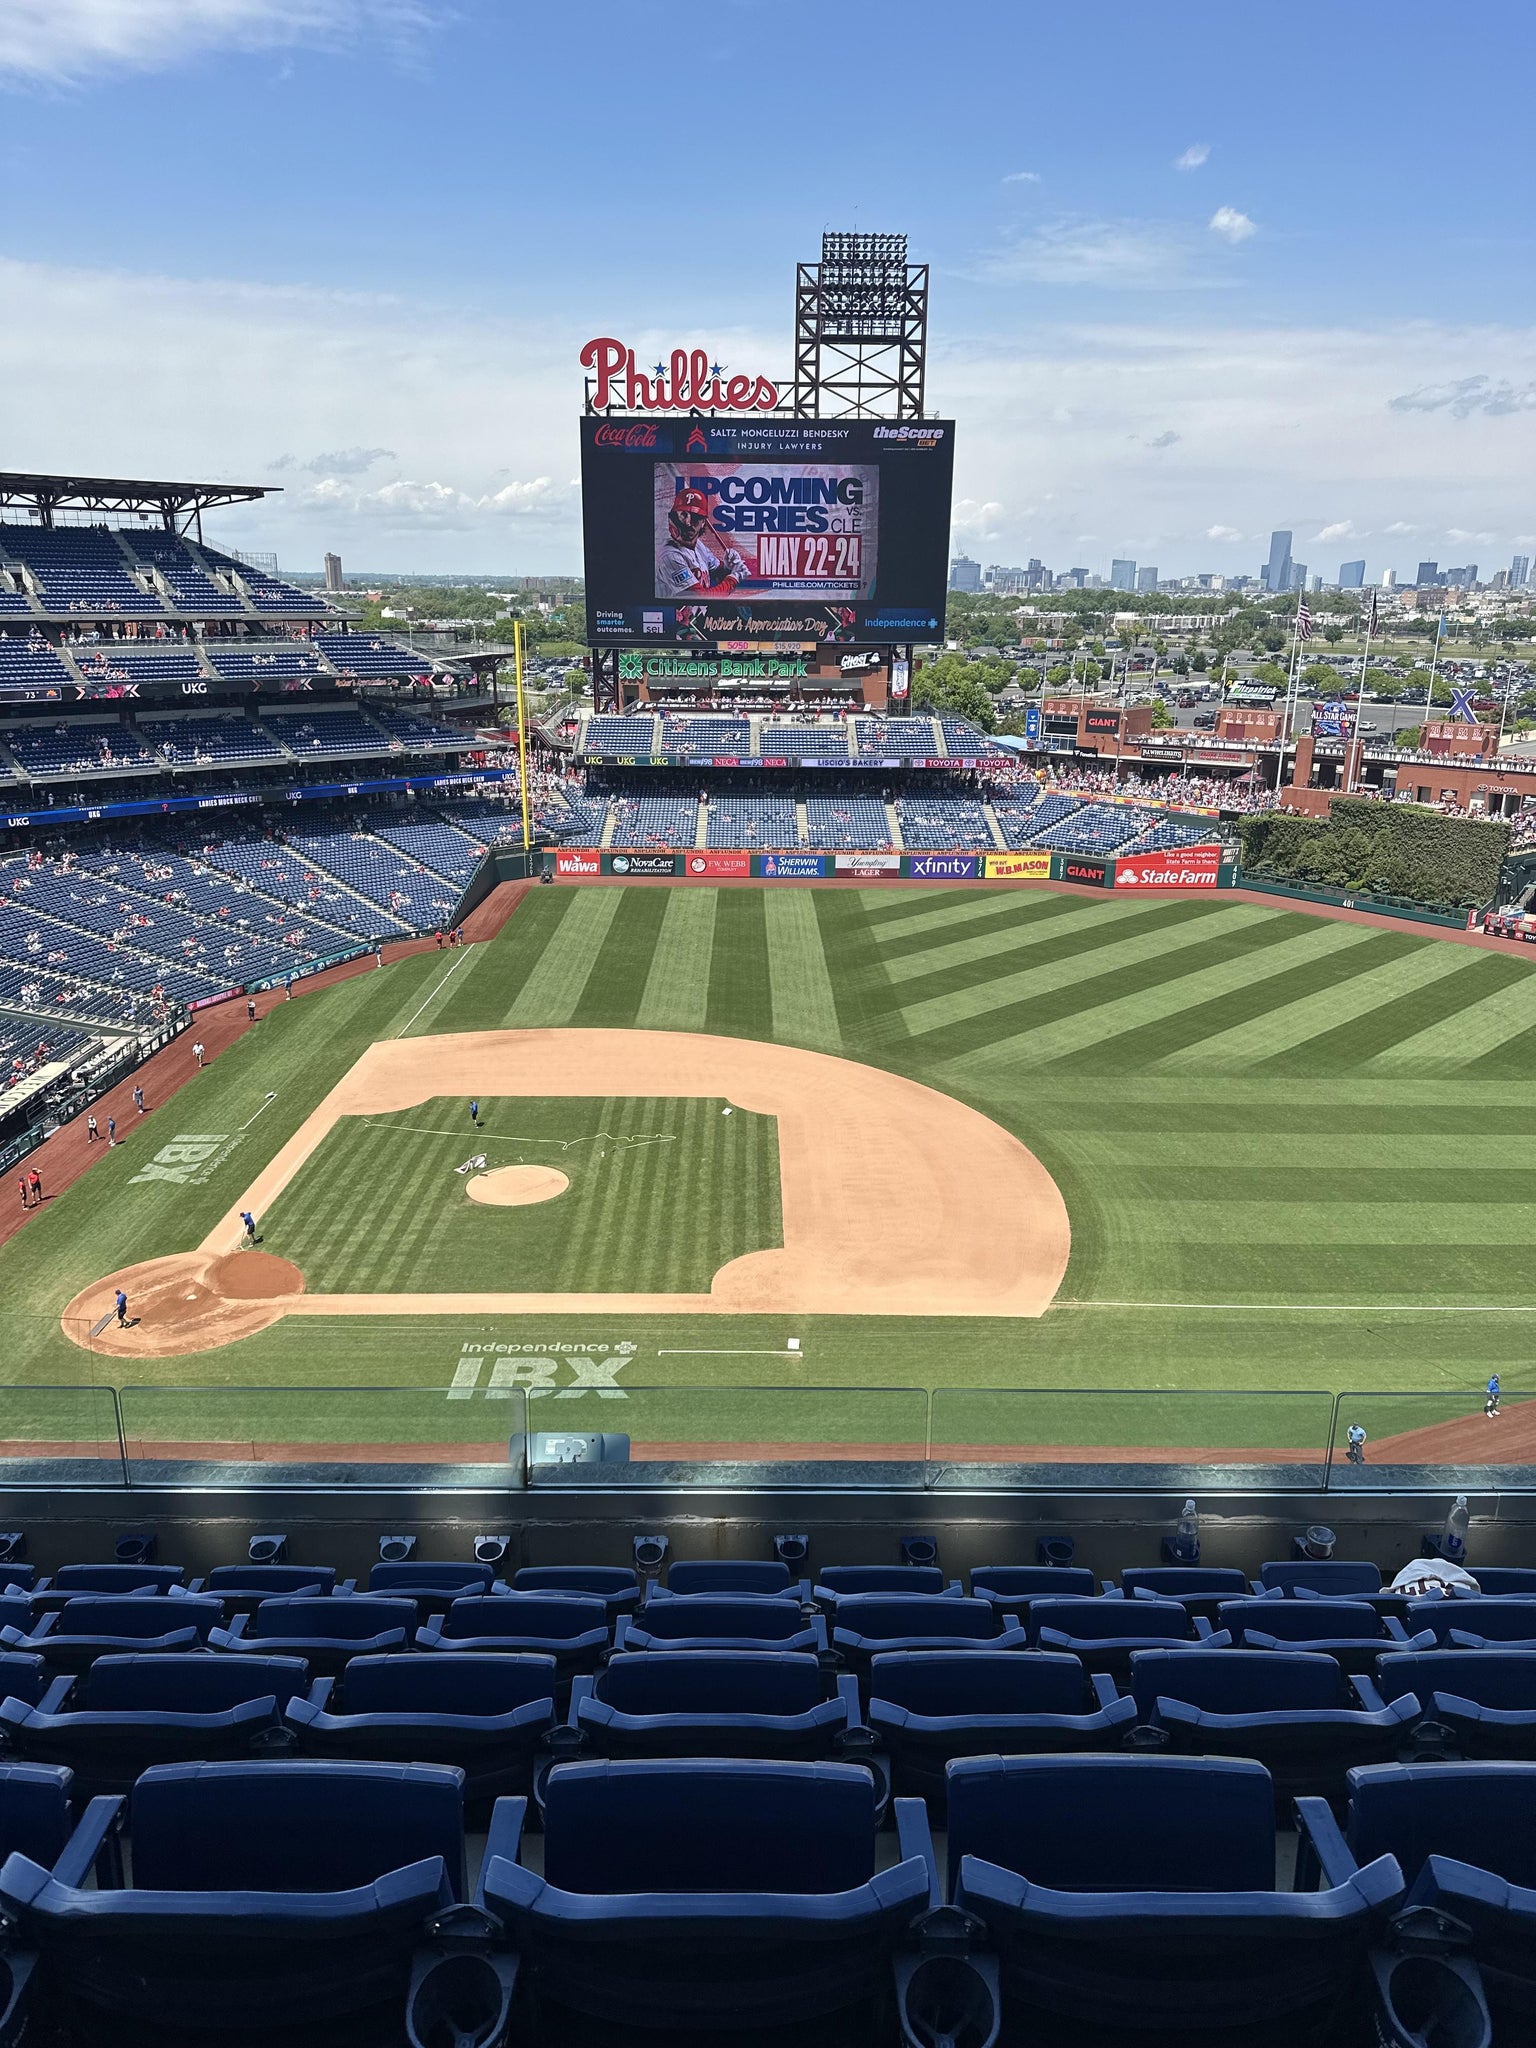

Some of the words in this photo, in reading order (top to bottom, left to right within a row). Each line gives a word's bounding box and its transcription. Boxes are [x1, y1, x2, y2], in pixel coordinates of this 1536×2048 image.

[580, 337, 779, 412] Phillies
[594, 424, 660, 447] Coca-Cola
[711, 428, 736, 438] SALTZ
[742, 429, 799, 438] MONGELUZZI
[803, 430, 850, 439] BENDESKY
[873, 426, 944, 439] theScore
[738, 442, 773, 451] INJURY
[779, 443, 823, 451] LAWYERS
[675, 476, 864, 506] UPCOMING
[713, 505, 830, 534] SERIES
[831, 519, 862, 533] CLE
[760, 537, 801, 576] MAY
[804, 537, 860, 576] 22-24
[674, 569, 691, 584] IBX
[772, 581, 859, 590] PHILLIES.COM/TICKETS
[596, 610, 623, 622] Driving
[596, 619, 626, 627] smarter
[703, 616, 743, 632] Mother's
[745, 617, 803, 634] Appreciation
[804, 617, 829, 638] Day
[864, 617, 927, 631] Independence
[596, 626, 636, 634] outcomes.
[774, 642, 802, 651] $15,920
[841, 651, 873, 671] GHOST
[645, 658, 718, 677] Citizens
[720, 658, 766, 677] Bank
[767, 659, 808, 678] Park
[182, 682, 208, 694] UKG
[1230, 680, 1278, 694] Fitzpatrick
[1088, 718, 1117, 727] GIANT
[1340, 712, 1358, 722] GAME
[584, 757, 603, 765] UKG
[617, 757, 636, 766] UKG
[650, 757, 669, 766] UKG
[715, 758, 739, 766] NECA
[764, 758, 787, 766] NECA
[818, 759, 850, 767] LISCIO'S
[929, 759, 960, 767] TOYOTA
[502, 773, 516, 781] UKG
[284, 791, 302, 800] UKG
[1489, 785, 1519, 795] TOYOTA
[8, 817, 30, 827] UKG
[1180, 852, 1193, 860] good
[559, 860, 598, 872] Wawa
[629, 857, 674, 868] NovaCare
[778, 857, 819, 867] SHERWIN
[847, 857, 888, 868] Yuengling
[914, 859, 973, 876] xfinity
[777, 866, 821, 876] WILLIAMS.
[1067, 866, 1105, 880] GIANT
[1342, 899, 1355, 909] 401
[127, 1134, 231, 1185] IBX
[461, 1342, 610, 1355] Independence
[446, 1356, 634, 1400] IBX
